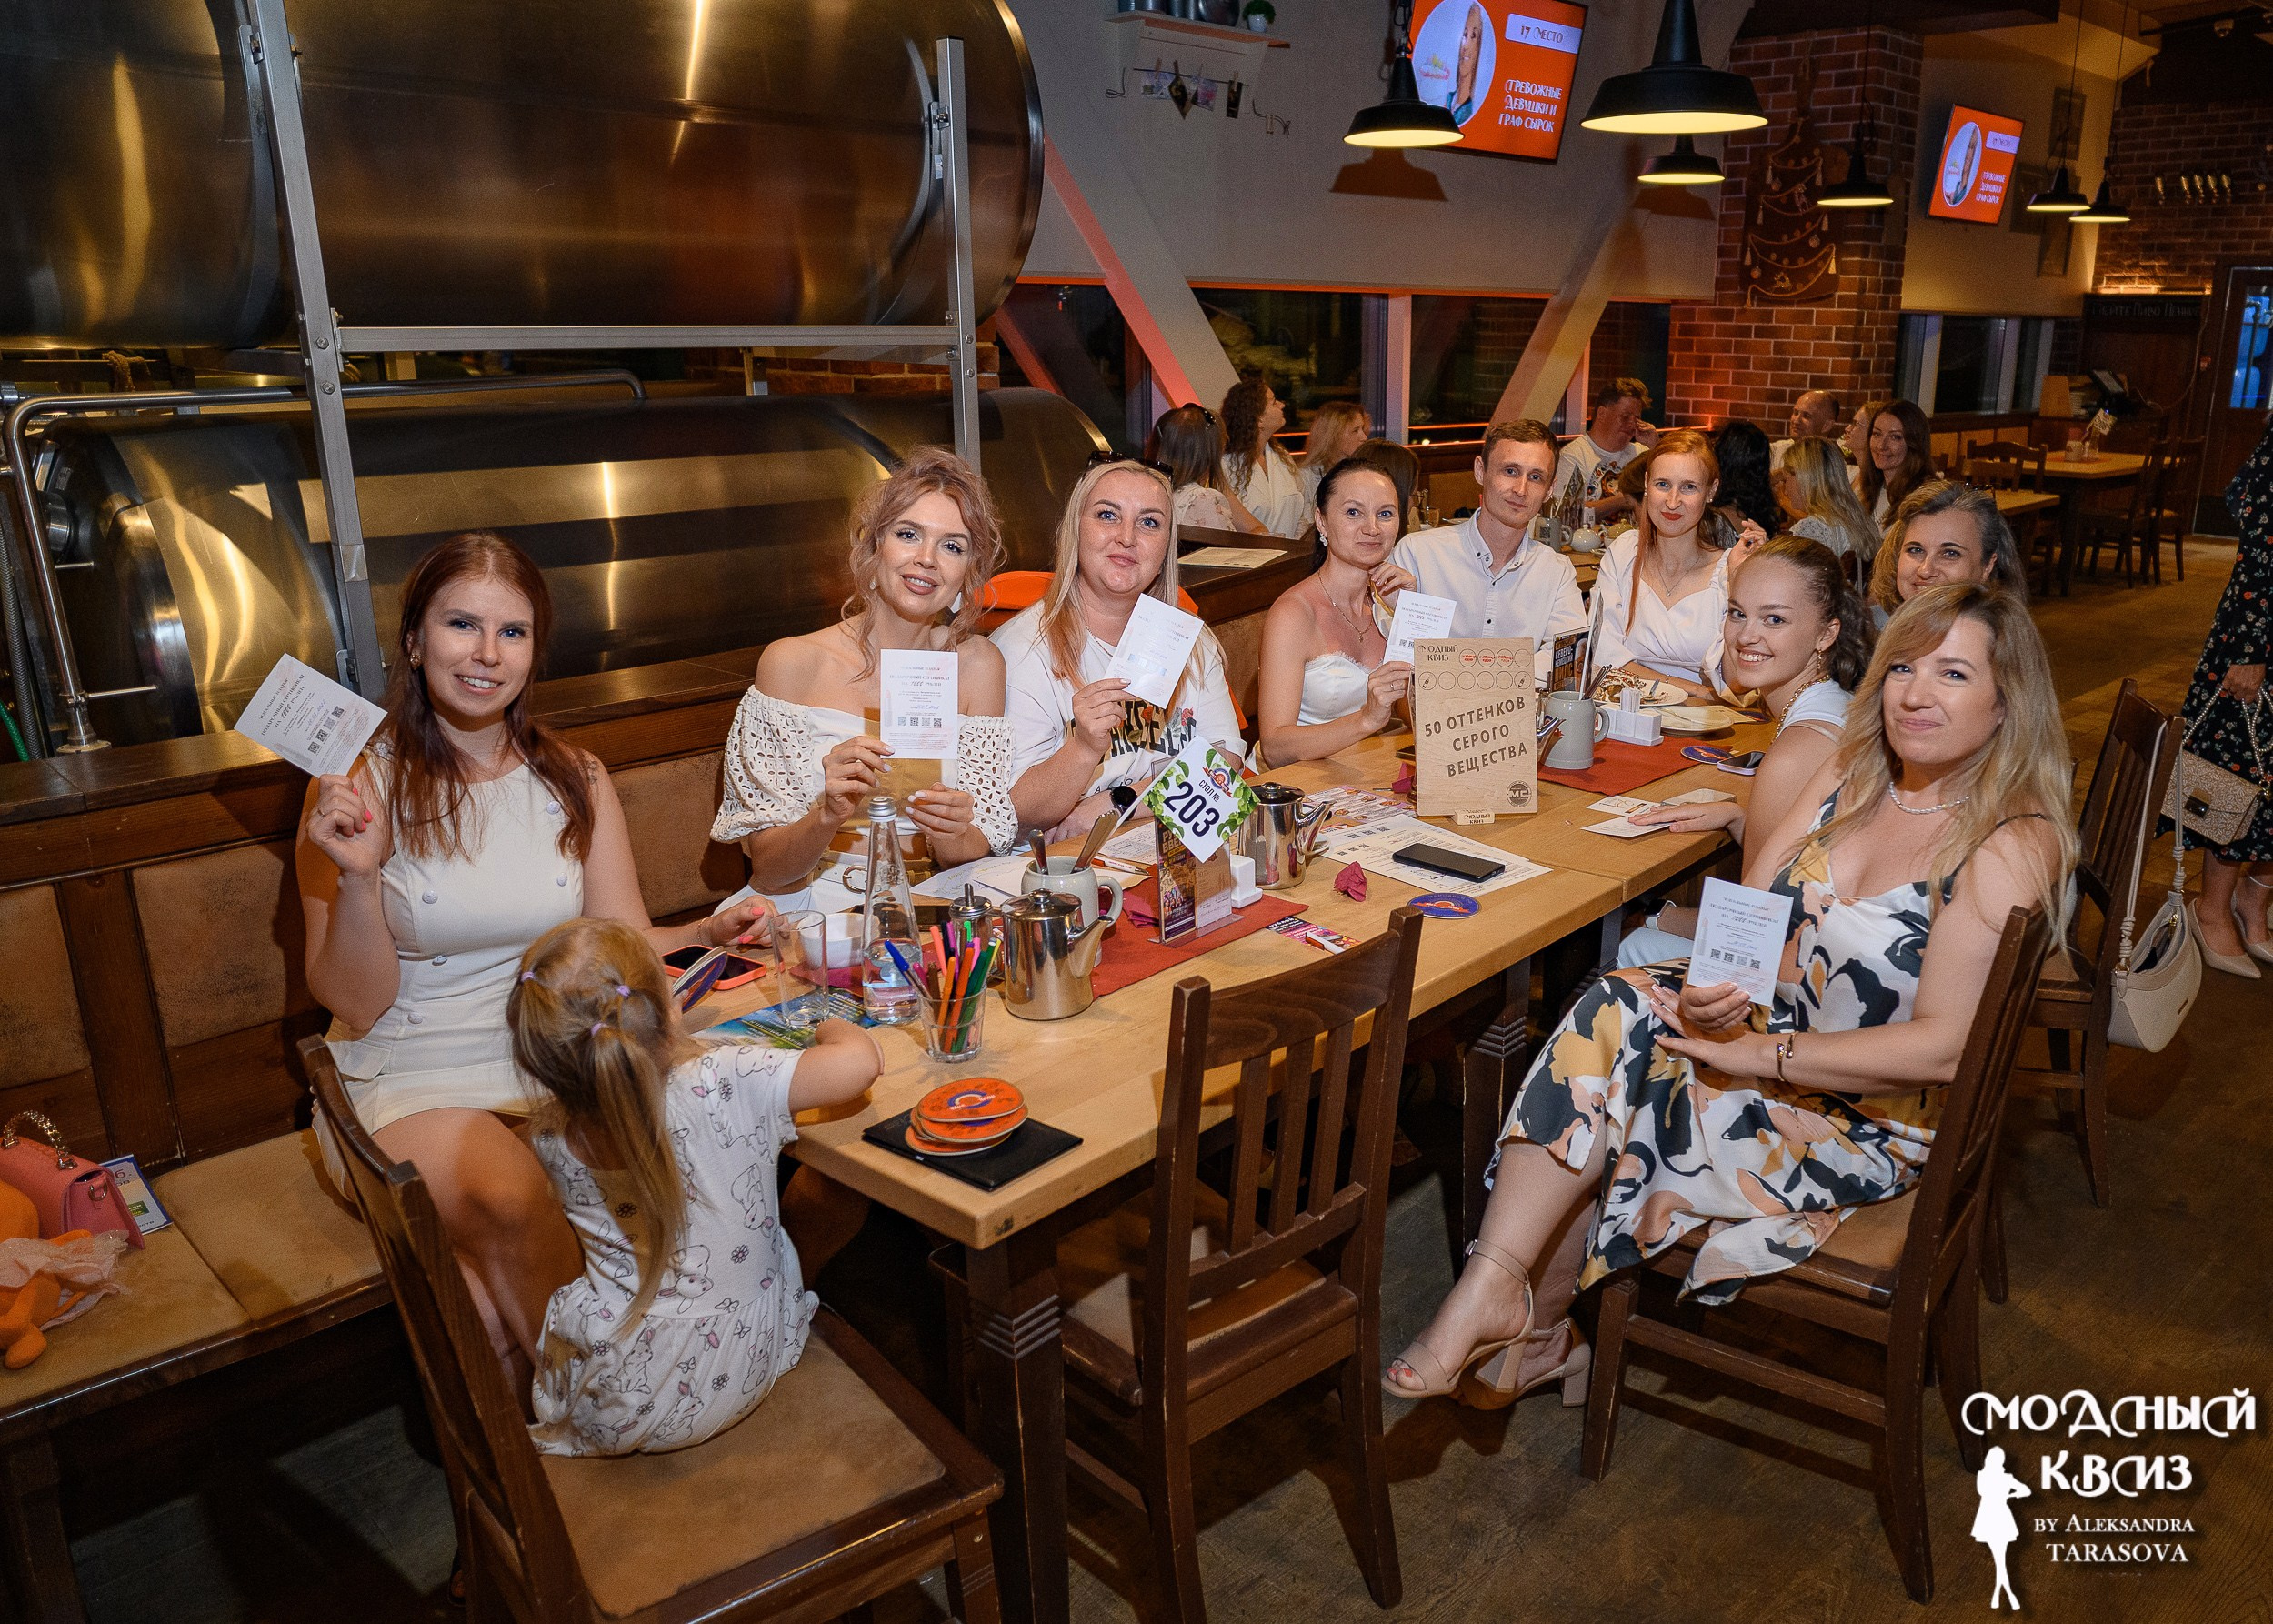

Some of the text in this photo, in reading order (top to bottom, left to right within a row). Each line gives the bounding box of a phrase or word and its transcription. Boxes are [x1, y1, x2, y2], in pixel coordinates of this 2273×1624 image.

[1521, 25, 1564, 44] 17 МЕСТО
[1504, 79, 1563, 100] ТРЕВОЖНЫЕ
[1504, 95, 1557, 115] ДЕВУШКИ И
[1497, 113, 1555, 133] ГРАФ СЫРОК
[1417, 644, 1458, 654] МОДНЫЙ
[1427, 654, 1449, 662] КВИЗ
[1425, 696, 1527, 737] 50 ОТТЕНКОВ
[1452, 724, 1509, 752] СЕРОГО
[1447, 742, 1528, 777] ВЕЩЕСТВА
[1198, 779, 1215, 797] СТОЛ
[1211, 792, 1220, 803] №
[1164, 781, 1220, 837] 203
